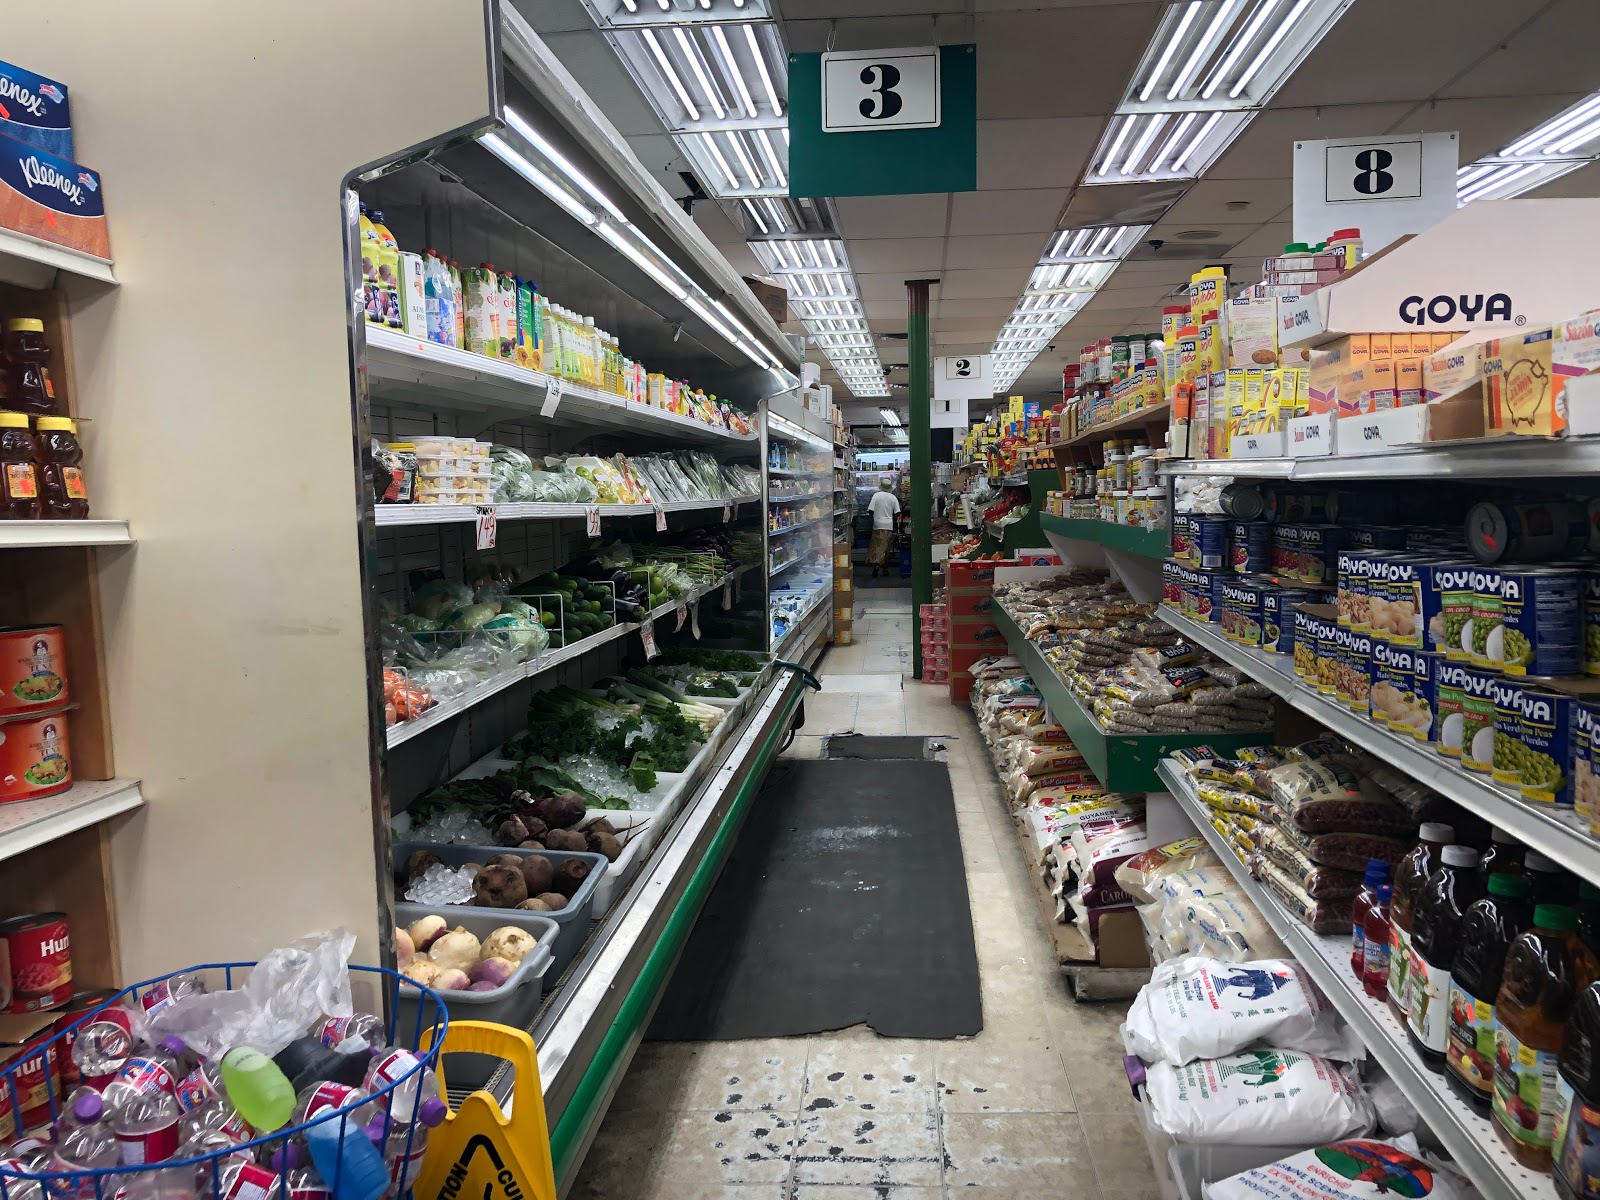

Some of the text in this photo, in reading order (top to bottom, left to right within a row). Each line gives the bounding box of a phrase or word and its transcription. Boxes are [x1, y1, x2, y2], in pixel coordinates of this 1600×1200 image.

[859, 64, 903, 119] 3
[1353, 149, 1394, 194] 8
[19, 155, 82, 206] Kleenex
[1200, 281, 1215, 289] OYA
[1399, 293, 1512, 325] GOYA
[1295, 309, 1309, 327] GOYA
[1565, 317, 1593, 342] Sazón
[1181, 344, 1195, 352] OYA
[956, 359, 971, 377] 2
[1447, 355, 1465, 370] GOYA
[1483, 359, 1503, 375] GOYA
[1306, 425, 1320, 439] GOYA
[1364, 425, 1380, 440] GOYA
[1507, 607, 1522, 615] Peas
[1502, 722, 1522, 732] Verd
[1534, 727, 1553, 738] Peas
[1525, 736, 1549, 746] Verdes
[1080, 809, 1119, 821] GUYANESE
[41, 936, 69, 957] Hun
[1208, 987, 1219, 1010] BRAND
[1208, 1075, 1218, 1093] BRAND
[1248, 1169, 1267, 1181] NET
[1279, 1184, 1291, 1193] 10
[1267, 1168, 1297, 1185] EXTRA
[1237, 1176, 1280, 1200] PRODUCT
